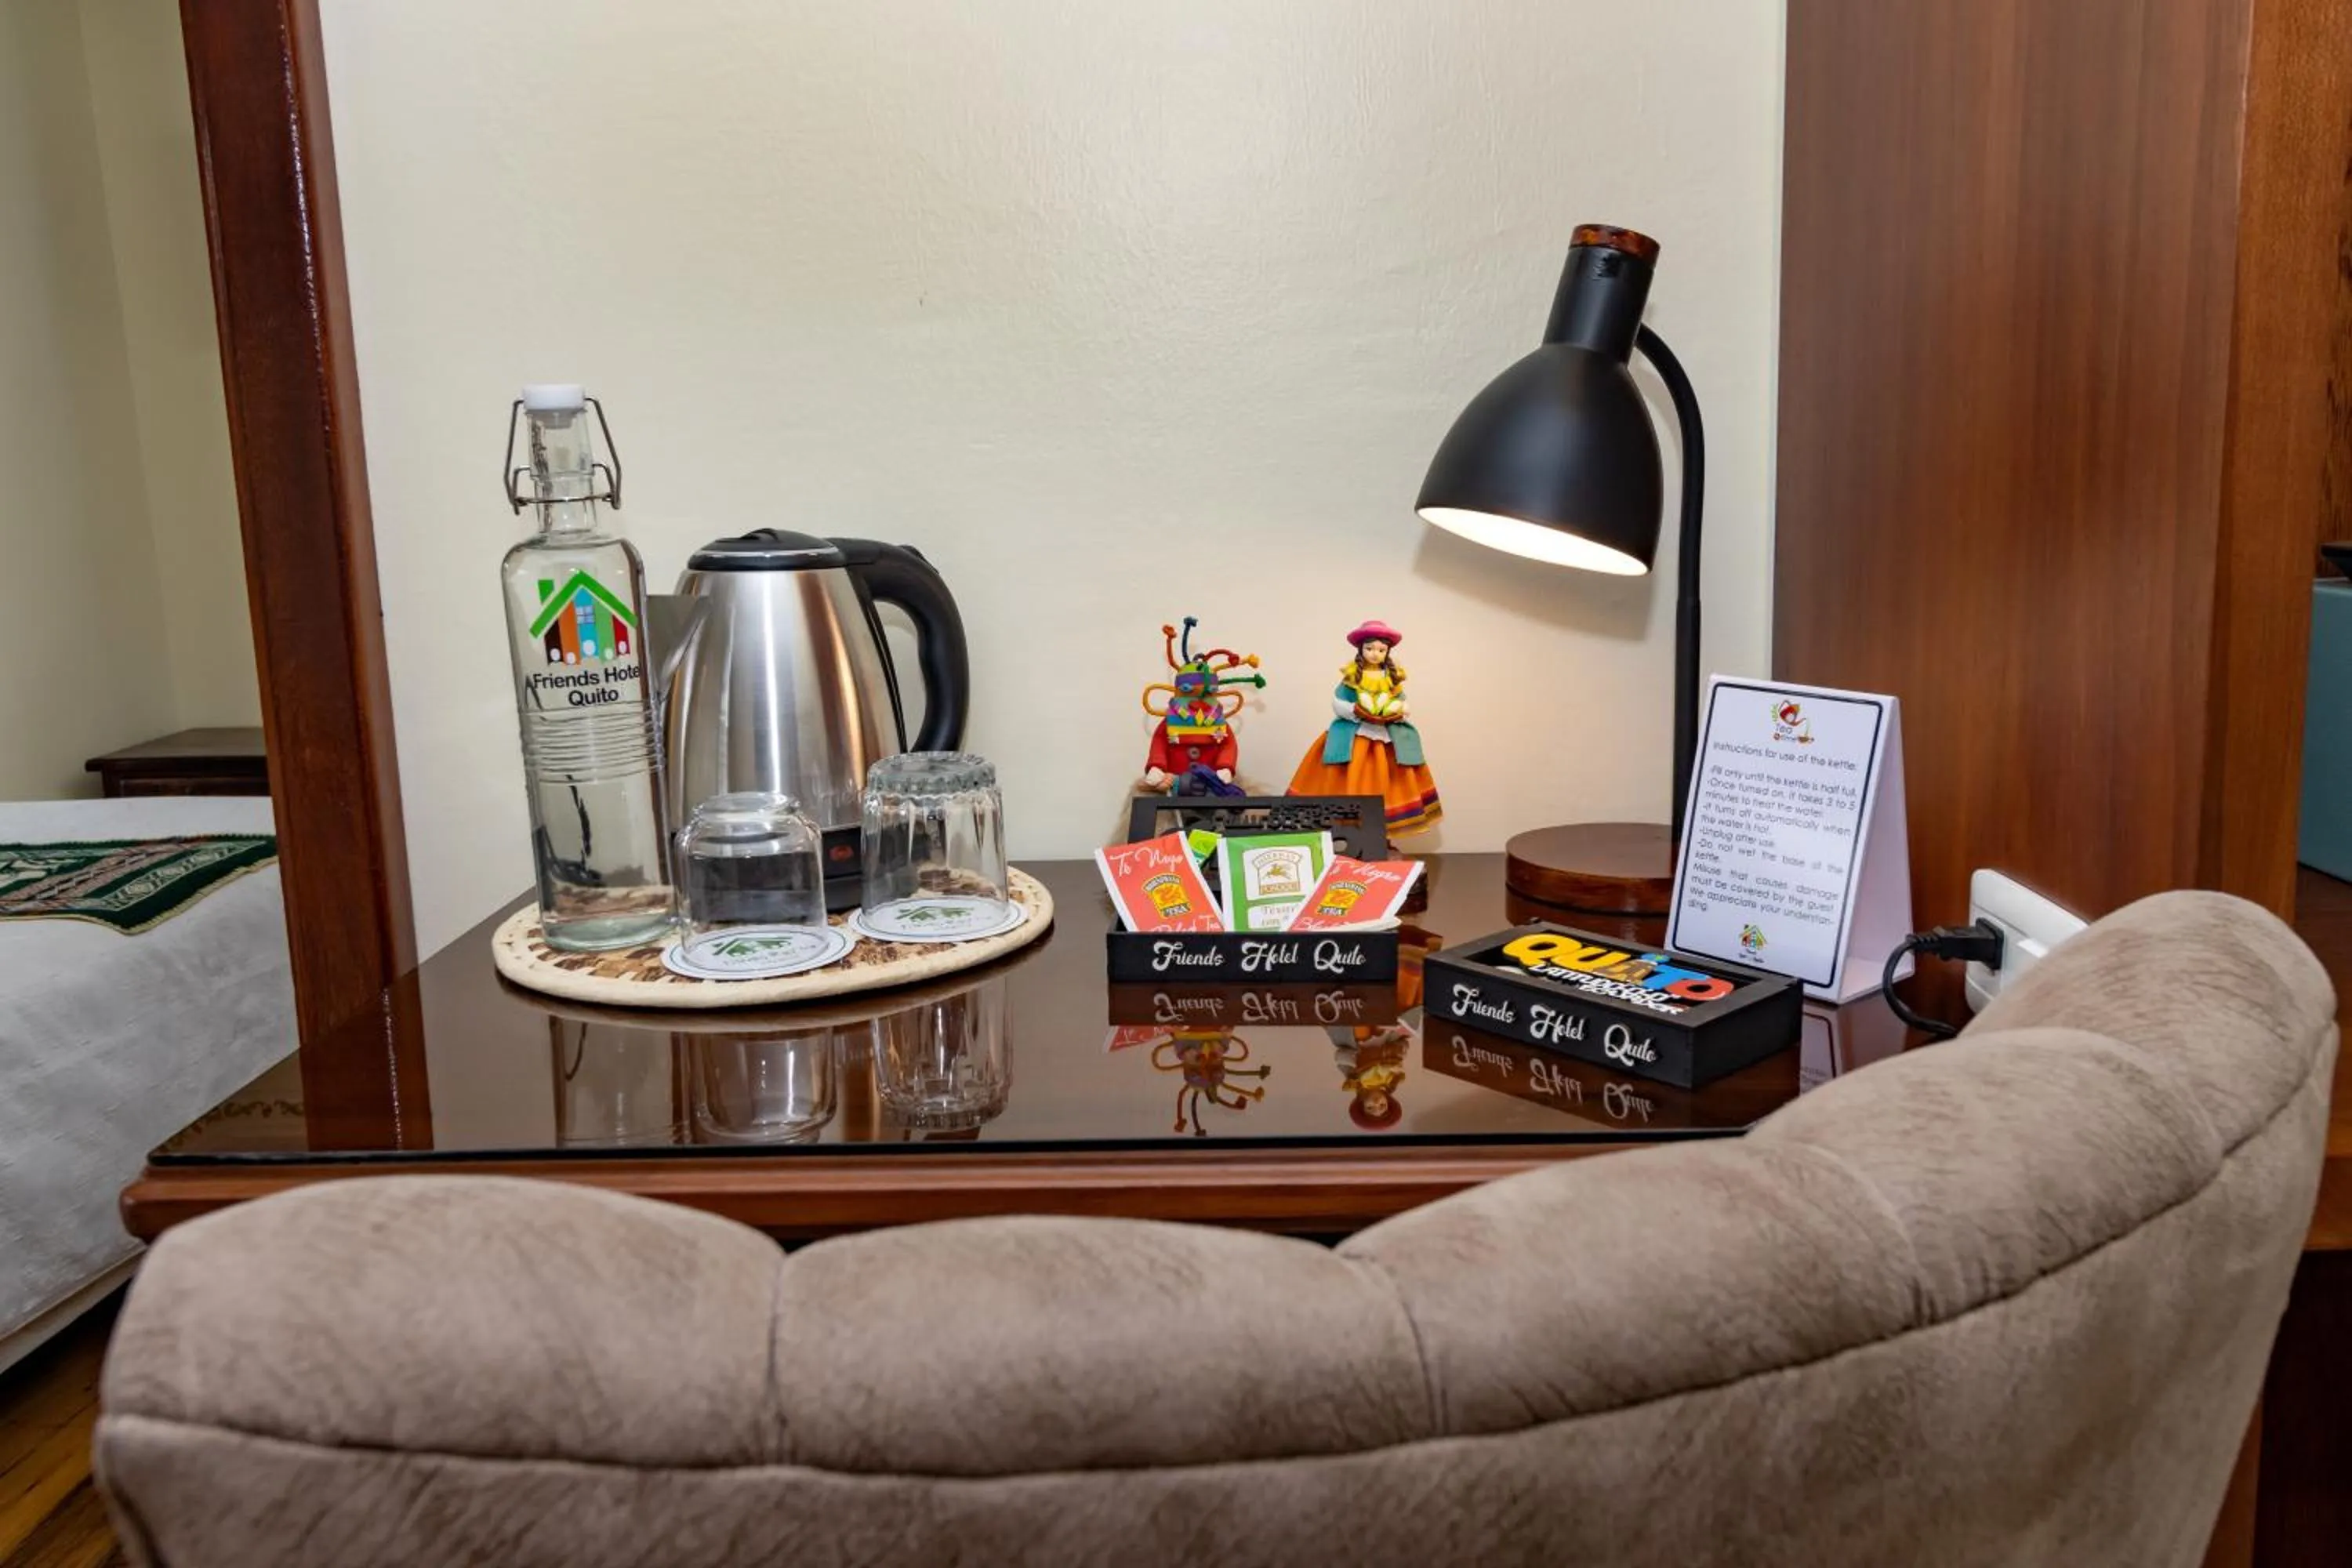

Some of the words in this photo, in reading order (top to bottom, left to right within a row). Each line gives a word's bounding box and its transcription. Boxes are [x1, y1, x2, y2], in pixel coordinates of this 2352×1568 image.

[533, 670, 600, 689] Friends
[604, 665, 641, 683] Hote
[568, 688, 619, 706] Quito
[1713, 742, 1763, 757] Instructions
[1765, 748, 1777, 758] for
[1779, 753, 1795, 762] use
[1797, 753, 1809, 763] of
[1810, 755, 1825, 766] the
[1738, 783, 1769, 796] turned
[1798, 792, 1824, 805] takes
[1835, 797, 1846, 808] to
[1766, 774, 1781, 785] the
[1784, 777, 1810, 789] kettle
[1820, 782, 1840, 794] half
[1705, 790, 1739, 804] minutes
[1741, 794, 1751, 805] to
[1752, 797, 1776, 809] heat
[1777, 800, 1793, 812] the
[1715, 804, 1736, 816] turns
[1739, 808, 1752, 819] off
[1755, 811, 1820, 831] automatically
[1823, 823, 1851, 836] when
[1718, 818, 1744, 829] water
[1735, 833, 1757, 844] after
[1718, 841, 1733, 852] not
[1738, 846, 1755, 857] wet
[1762, 851, 1777, 862] the
[1782, 855, 1806, 867] base
[1811, 860, 1822, 870] of
[1827, 863, 1844, 874] the
[1691, 875, 1713, 887] must
[1715, 879, 1727, 891] be
[1730, 884, 1769, 899] covered
[1773, 891, 1787, 904] by
[1788, 894, 1804, 907] the
[1693, 862, 1722, 876] Misuse
[1730, 869, 1748, 881] that
[1755, 877, 1788, 890] causes
[1796, 884, 1838, 901] damage
[1690, 887, 1705, 898] We
[1707, 890, 1757, 909] appreciate
[1760, 902, 1781, 915] your
[1152, 941, 1225, 971] Friends
[1241, 941, 1299, 972] Hotel
[1313, 940, 1366, 974] Quito
[1451, 983, 1515, 1024] Friends
[1530, 1004, 1585, 1044] Hotel
[1604, 1023, 1657, 1067] Quito
